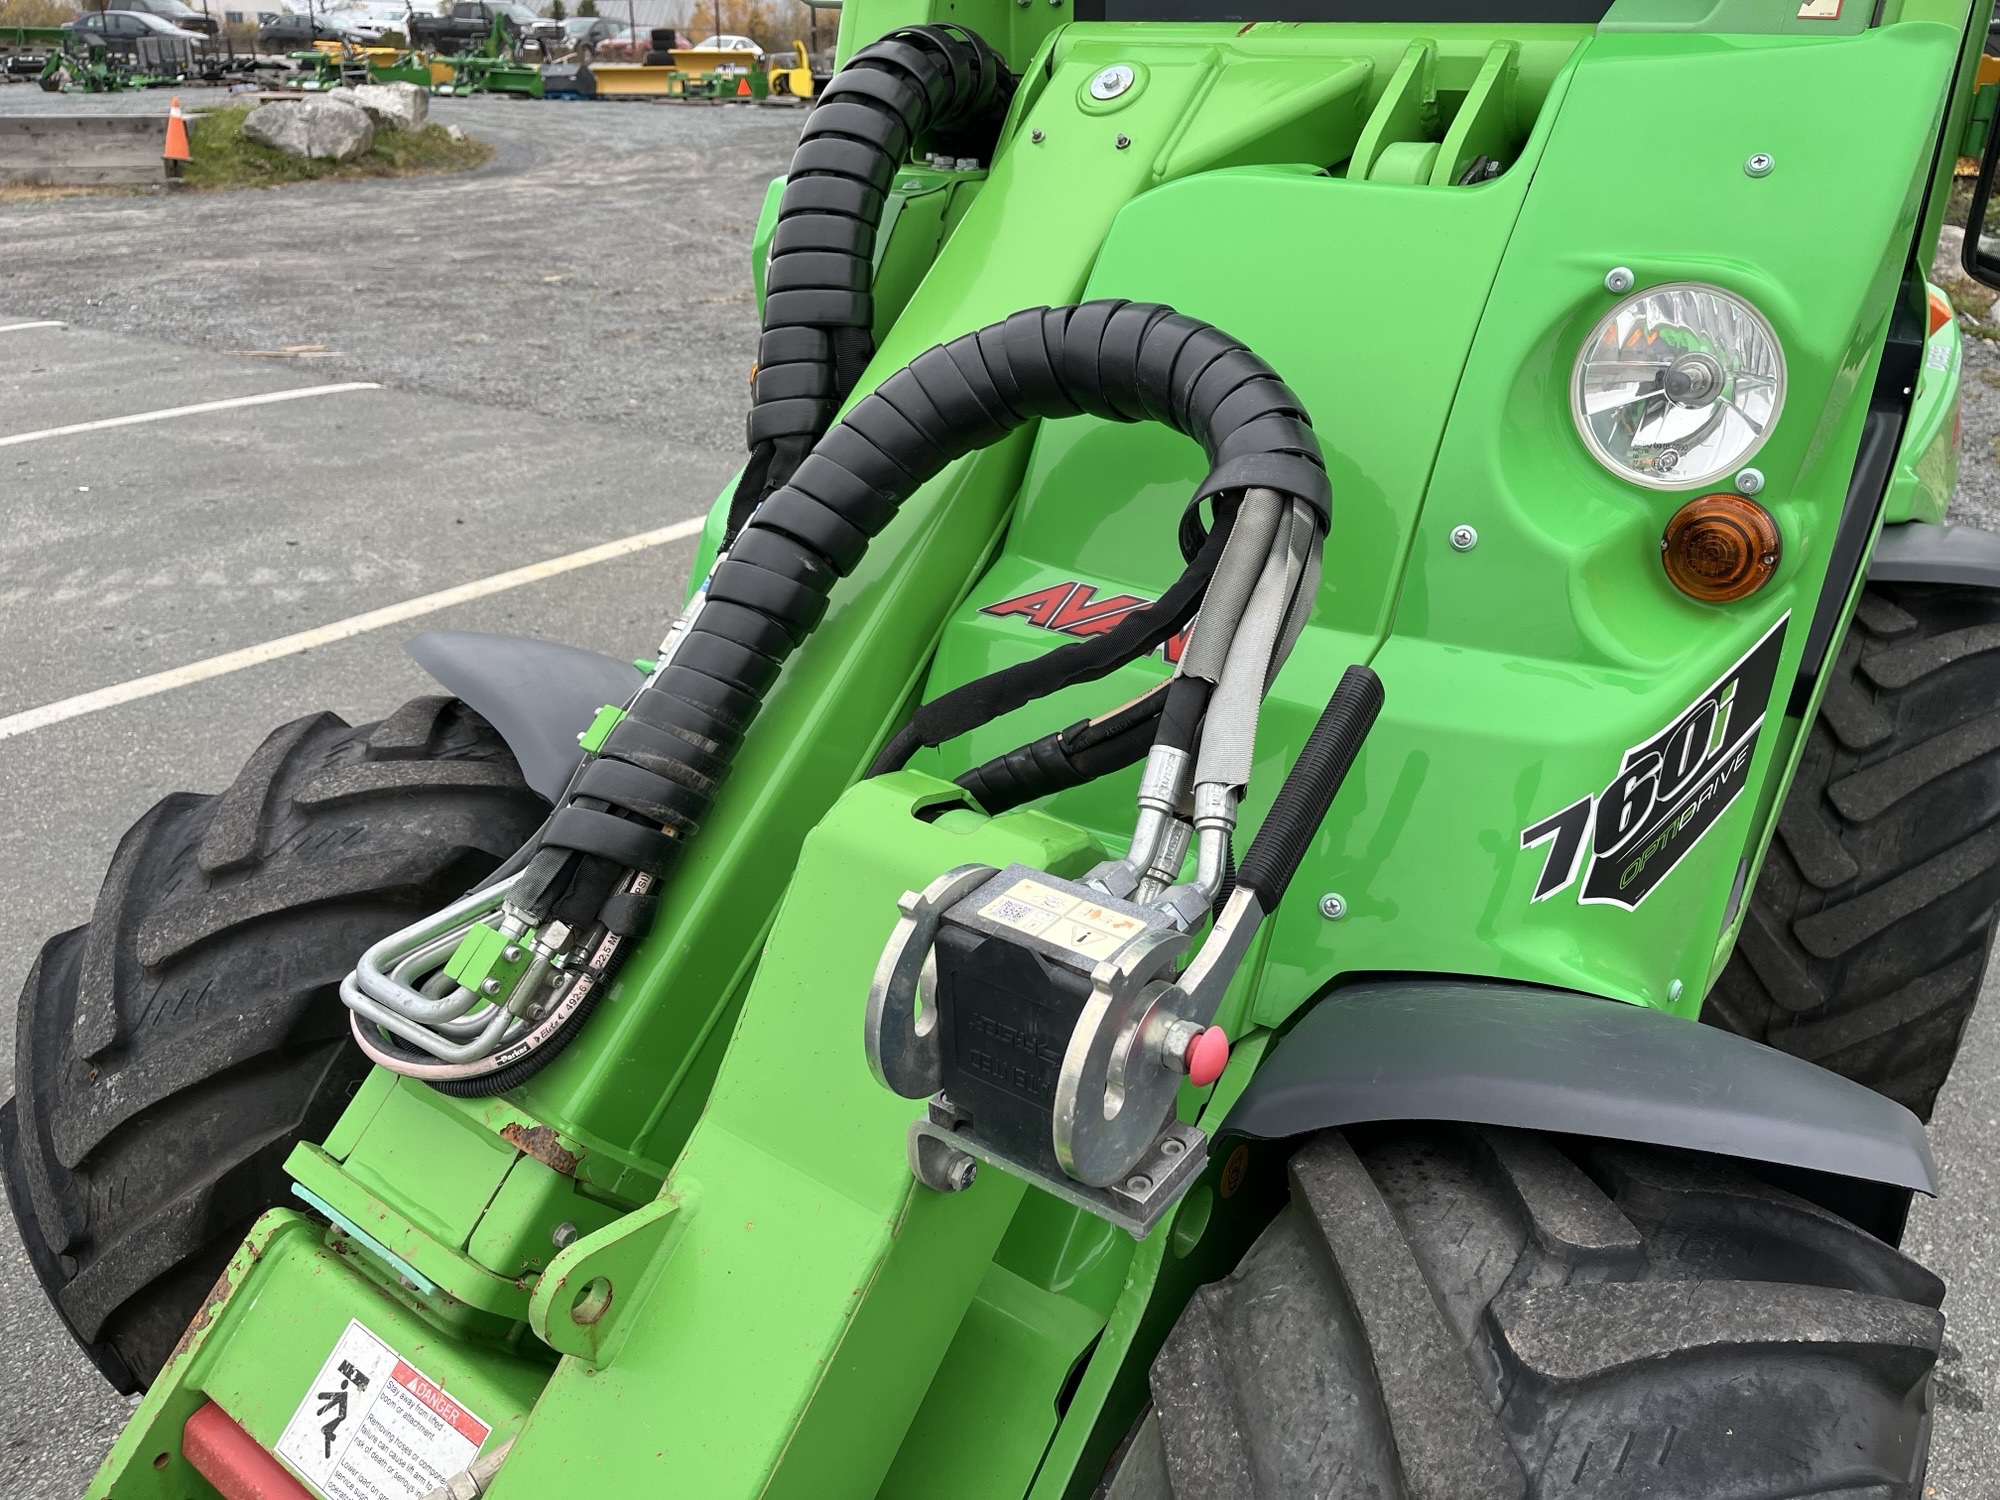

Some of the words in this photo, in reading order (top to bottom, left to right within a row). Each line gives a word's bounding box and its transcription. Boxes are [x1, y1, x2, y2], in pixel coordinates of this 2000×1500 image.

[1520, 677, 1739, 904] 760i
[1619, 745, 1749, 890] OPTIDRIVE
[499, 1044, 529, 1064] Parker
[565, 984, 588, 1012] 492-6
[595, 946, 612, 968] 22,5
[380, 1392, 397, 1412] boom
[395, 1405, 407, 1414] or
[386, 1380, 400, 1397] Stay
[399, 1392, 415, 1410] away
[415, 1403, 430, 1419] from
[428, 1414, 445, 1432] lifted
[415, 1382, 461, 1426] DANGER
[360, 1424, 378, 1445] failure
[377, 1441, 390, 1454] can
[388, 1449, 407, 1469] cause
[405, 1461, 416, 1475] lift
[413, 1470, 428, 1486] arm
[425, 1479, 433, 1492] to
[367, 1412, 395, 1443] Removing
[394, 1437, 413, 1457] hoses
[411, 1451, 420, 1461] or
[333, 1470, 355, 1491] service
[340, 1456, 359, 1477] Lower
[357, 1472, 373, 1489] load
[370, 1485, 380, 1497] on
[354, 1436, 366, 1449] risk
[364, 1444, 374, 1455] of
[371, 1451, 388, 1470] death
[386, 1465, 395, 1475] or
[393, 1471, 415, 1493] serious
